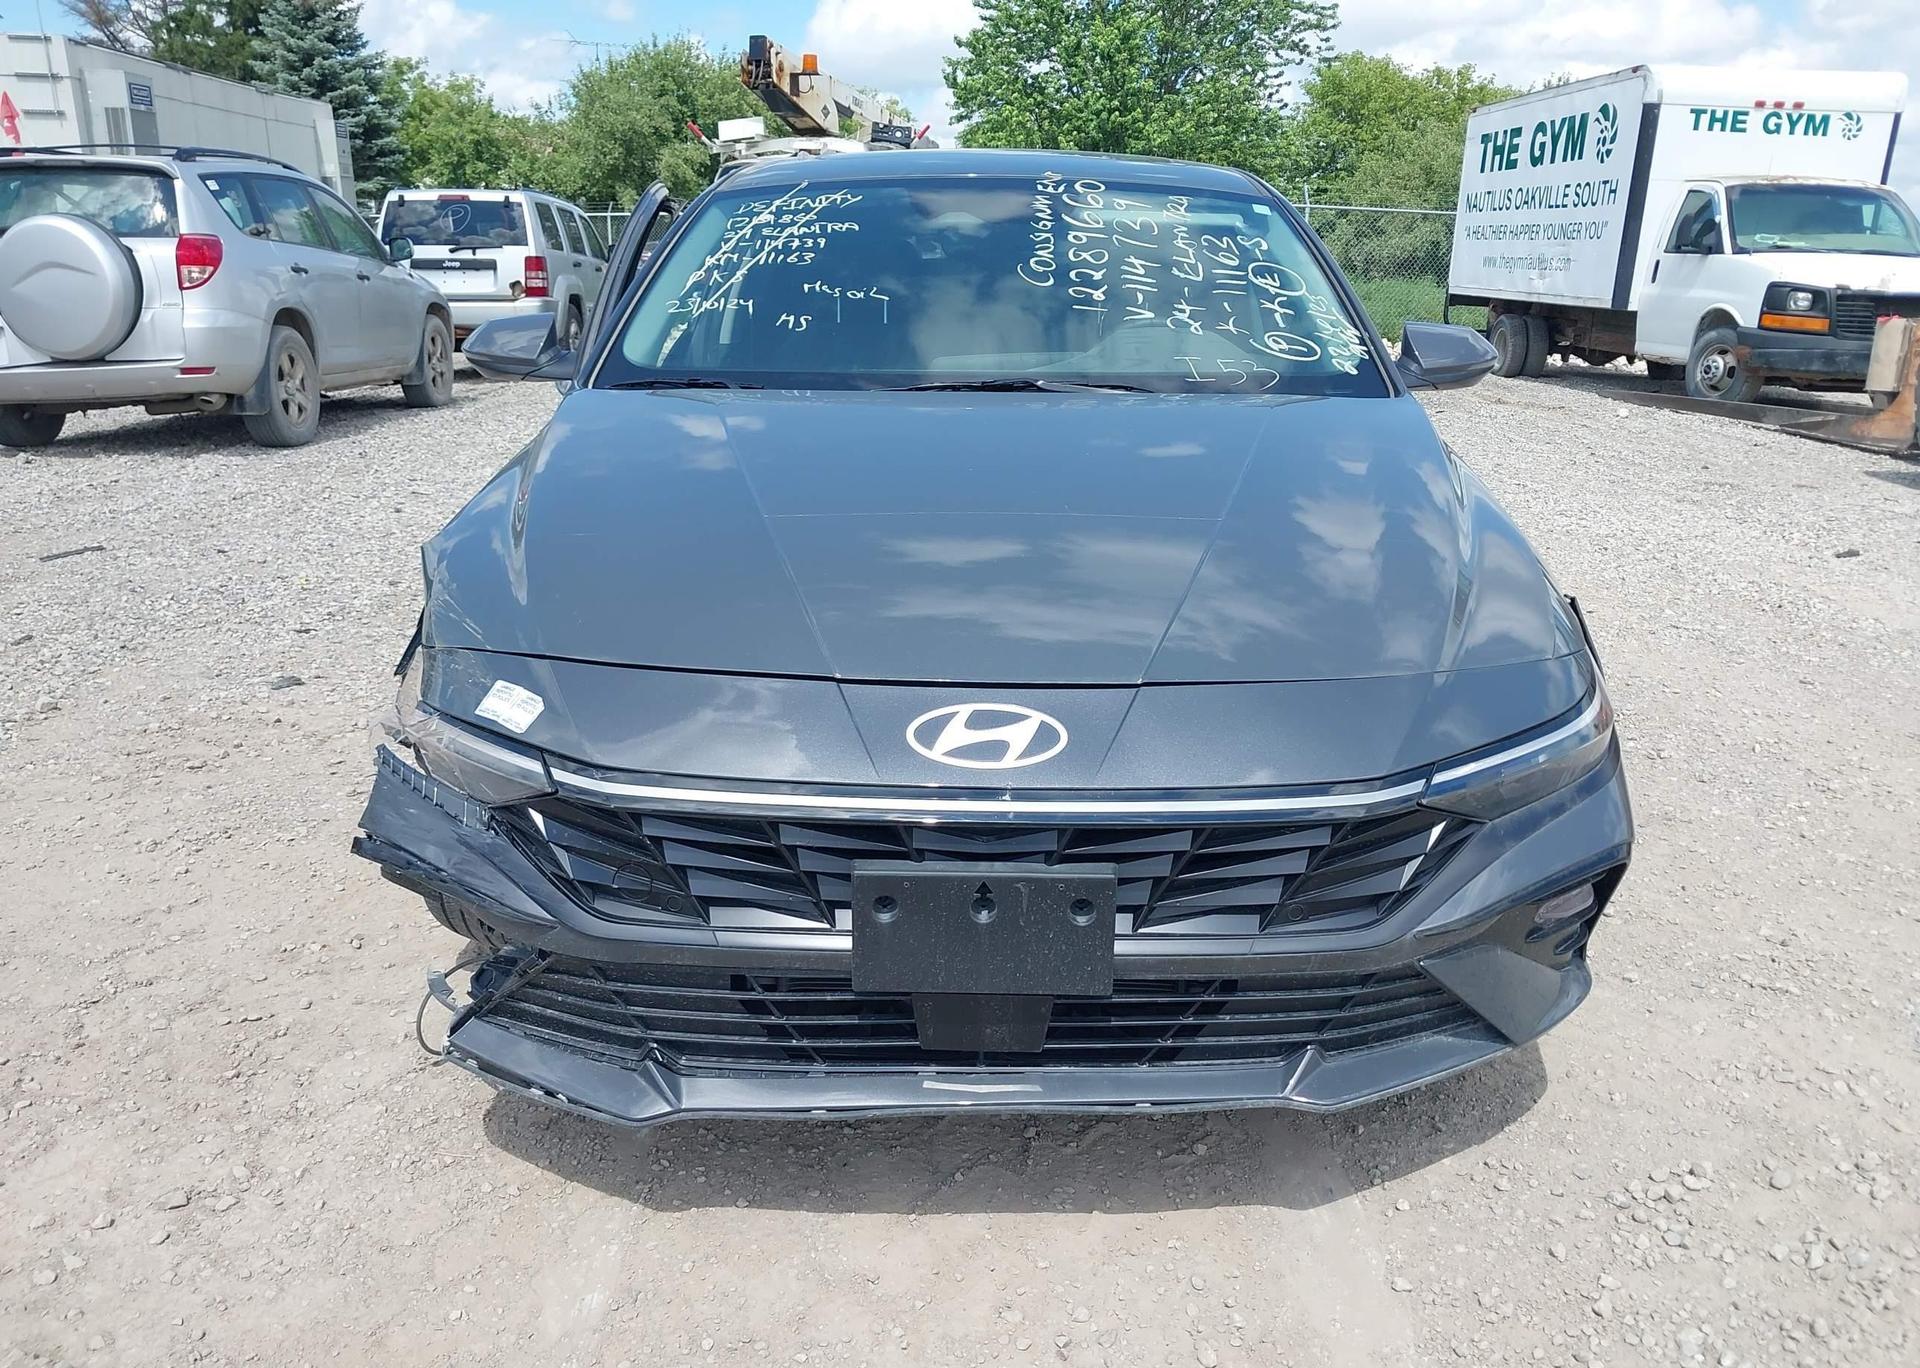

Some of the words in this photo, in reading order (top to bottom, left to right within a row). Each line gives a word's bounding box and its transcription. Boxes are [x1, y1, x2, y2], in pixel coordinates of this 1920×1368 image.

[1689, 107, 1750, 133] THE
[1762, 111, 1832, 137] GYM
[1479, 126, 1523, 174] THE
[1529, 111, 1590, 168] GYM
[1465, 188, 1512, 214] NAUTILUS
[1514, 183, 1571, 210] OAKVILLE
[1572, 178, 1619, 208] SOUTH
[1472, 224, 1508, 241] HEALTHIER
[1508, 223, 1541, 240] HAPPIER
[1542, 222, 1583, 240] YOUNGER
[442, 260, 461, 268] Jeep
